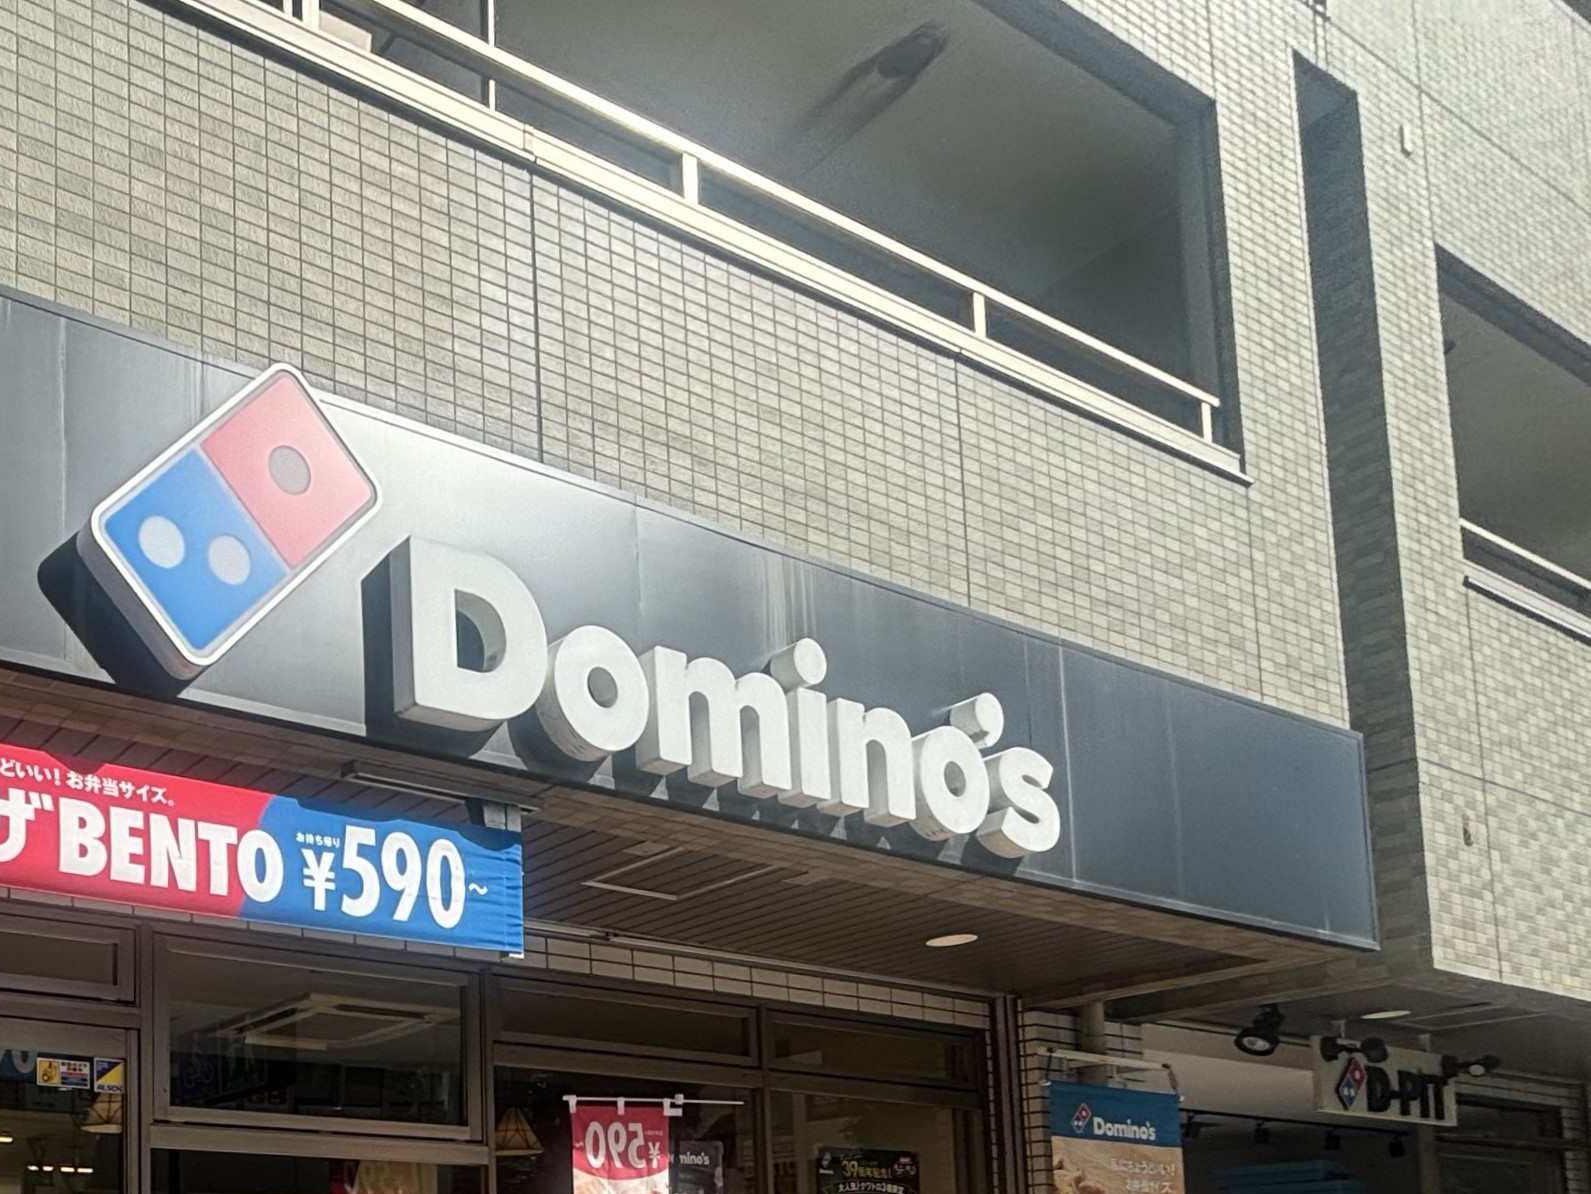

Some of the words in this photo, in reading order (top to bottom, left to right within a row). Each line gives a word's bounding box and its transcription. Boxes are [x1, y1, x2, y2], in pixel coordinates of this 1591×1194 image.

[396, 536, 1060, 856] Domino's
[67, 770, 176, 807] お弁当サイズ。
[59, 796, 285, 903] BENTO
[296, 831, 341, 849] お持ち帰り
[1092, 1116, 1156, 1141] Domino's
